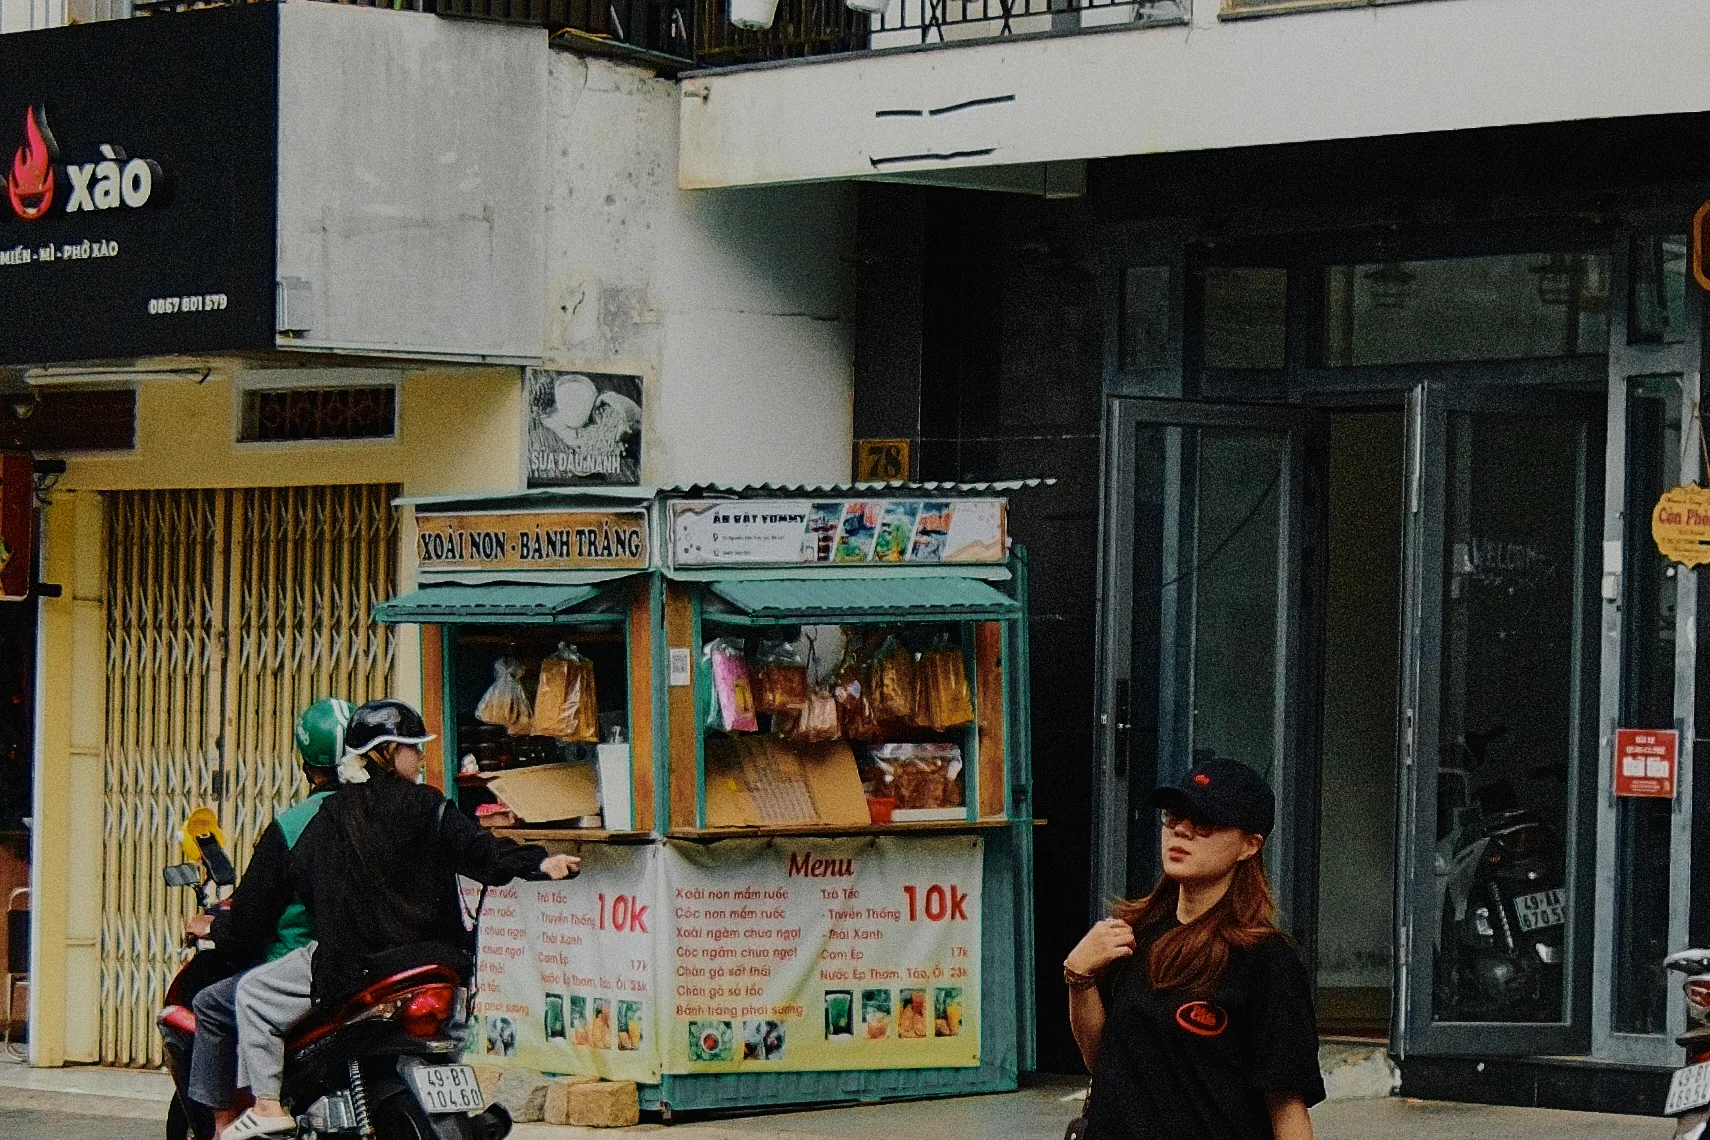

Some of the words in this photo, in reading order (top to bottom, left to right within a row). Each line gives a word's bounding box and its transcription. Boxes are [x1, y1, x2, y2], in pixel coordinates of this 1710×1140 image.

[66, 143, 152, 212] xào
[869, 445, 901, 478] 78
[421, 524, 464, 561] XOÀI
[469, 531, 506, 560] NON
[519, 523, 571, 560] BÁNH
[575, 520, 642, 558] TRÁNG
[788, 851, 855, 877] Menu
[599, 893, 649, 933] 10k
[903, 884, 968, 922] 10k
[427, 1067, 468, 1087] 49-B1
[427, 1088, 480, 1109] 104.60
